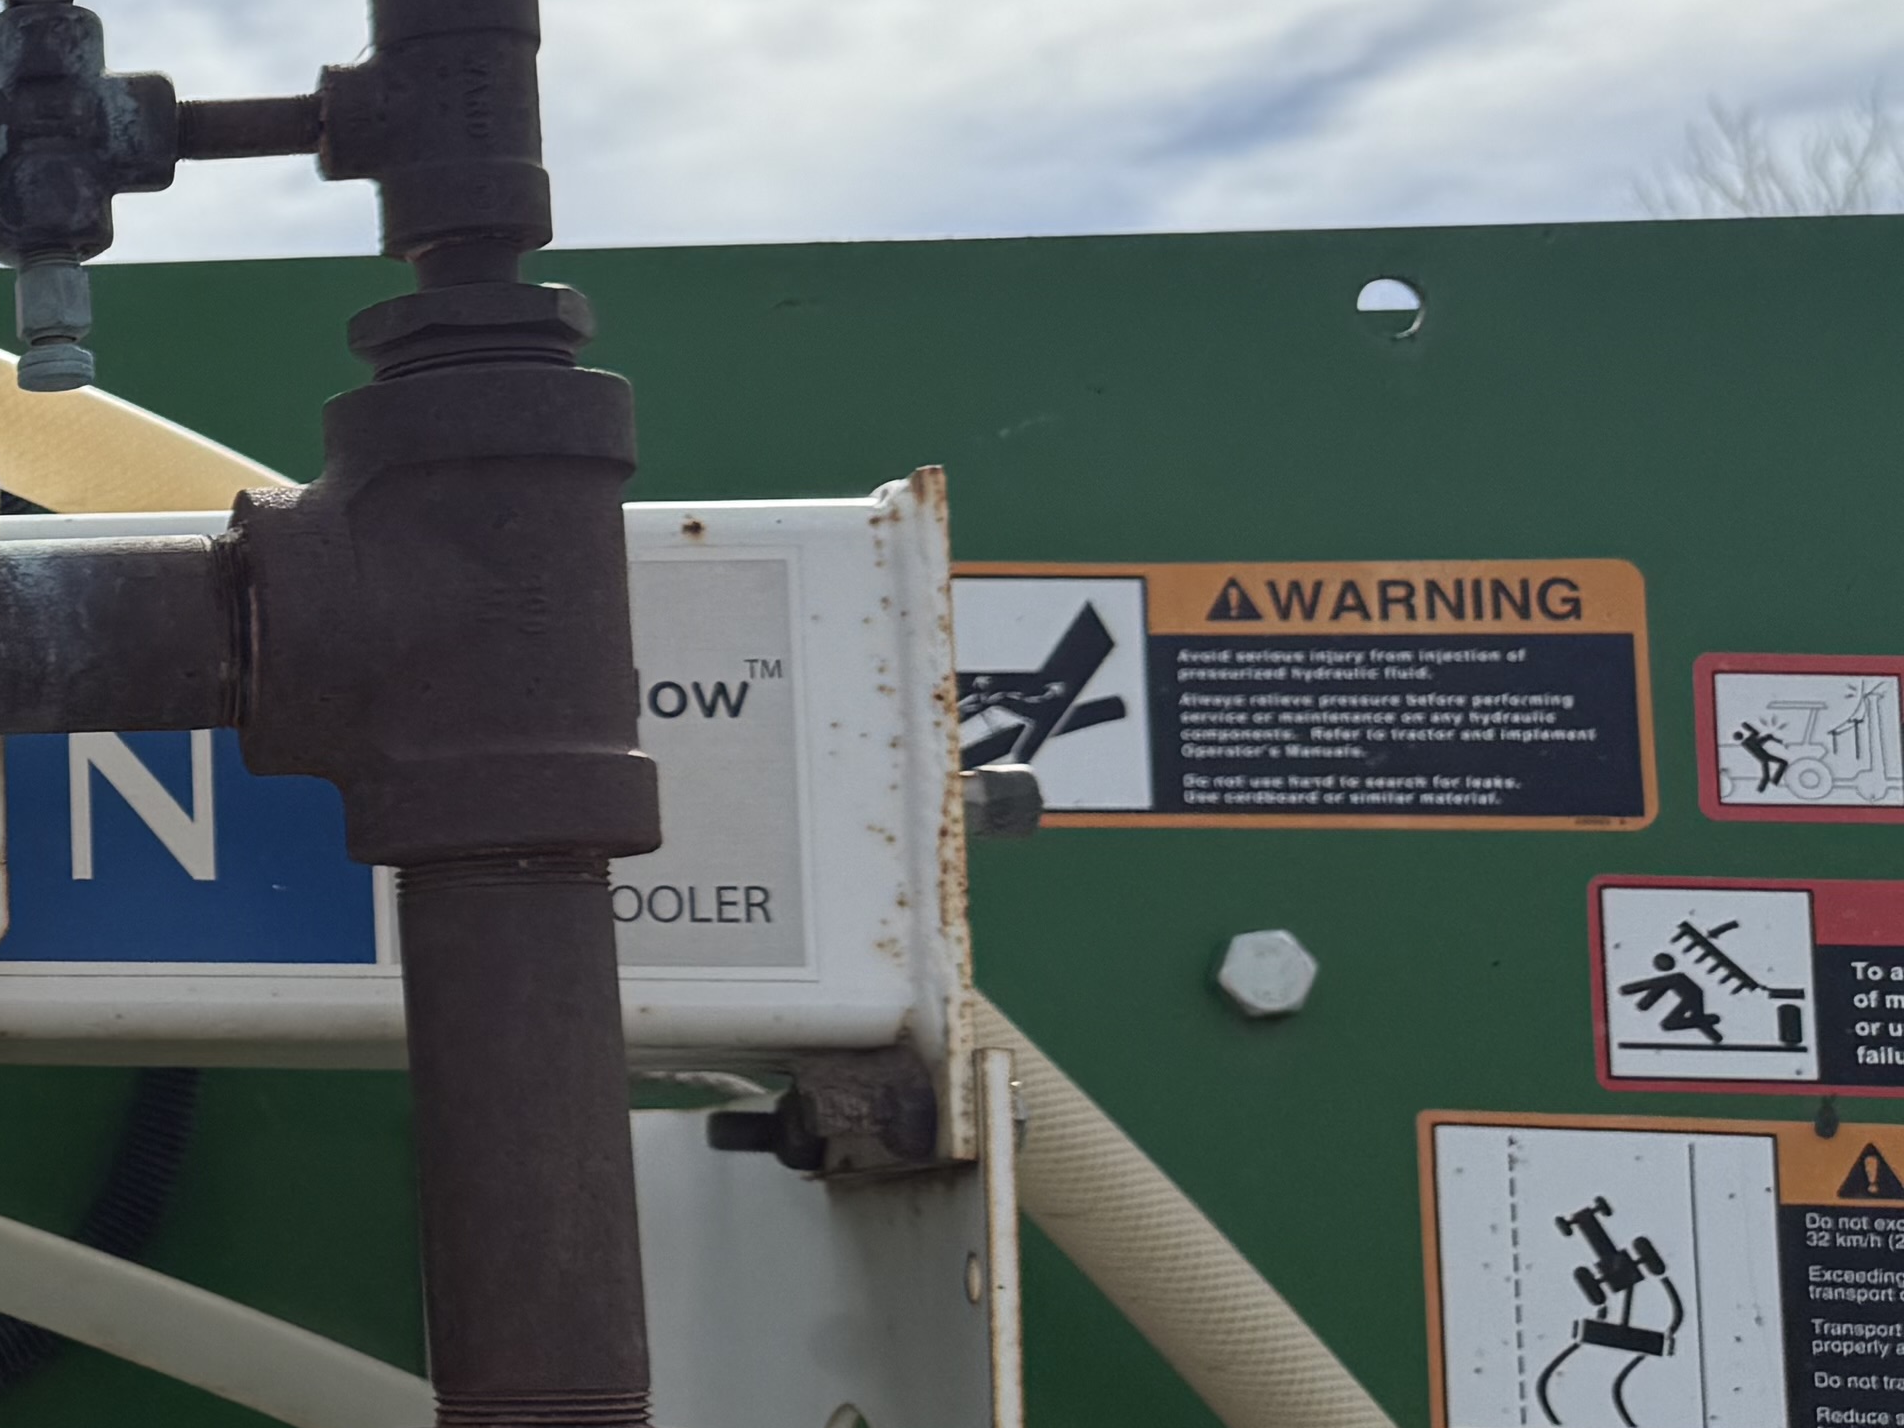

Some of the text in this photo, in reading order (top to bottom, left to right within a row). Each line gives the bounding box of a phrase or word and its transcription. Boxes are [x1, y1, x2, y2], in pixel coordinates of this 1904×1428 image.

[1266, 577, 1582, 622] WARNING
[1177, 648, 1232, 663] Avoid
[1309, 649, 1366, 665] injury
[1369, 648, 1414, 663] from
[1418, 649, 1501, 665] injection
[1506, 648, 1526, 662] of
[1177, 668, 1287, 681] pressurized
[1291, 667, 1380, 682] hydraulic
[1178, 692, 1246, 708] Always
[1318, 694, 1401, 709] pressure
[1472, 693, 1575, 709] performing
[1278, 711, 1397, 724] maintenance
[1469, 711, 1556, 726] hydraulic
[1460, 728, 1494, 741] and
[1501, 728, 1597, 743] implement
[1183, 773, 1210, 789] Do
[1213, 775, 1246, 788] not
[1249, 775, 1284, 789] use
[1340, 775, 1360, 788] to
[1365, 776, 1428, 789] search
[1433, 775, 1460, 789] for
[1184, 789, 1221, 804] Use
[1224, 791, 1319, 804] cardboard
[1323, 792, 1343, 804] or
[1349, 792, 1414, 805] similar
[1851, 961, 1884, 981] To
[1853, 990, 1879, 1008] of
[1855, 1021, 1881, 1036] or
[1805, 1213, 1869, 1230] Do not
[1806, 1232, 1882, 1248] 32 km/h
[1809, 1266, 1904, 1287] Exceeding
[1809, 1285, 1893, 1304] transport
[1811, 1318, 1902, 1339] Transport
[1812, 1340, 1889, 1358] properly
[1814, 1372, 1878, 1390] Do not
[1816, 1407, 1889, 1425] Reduce
